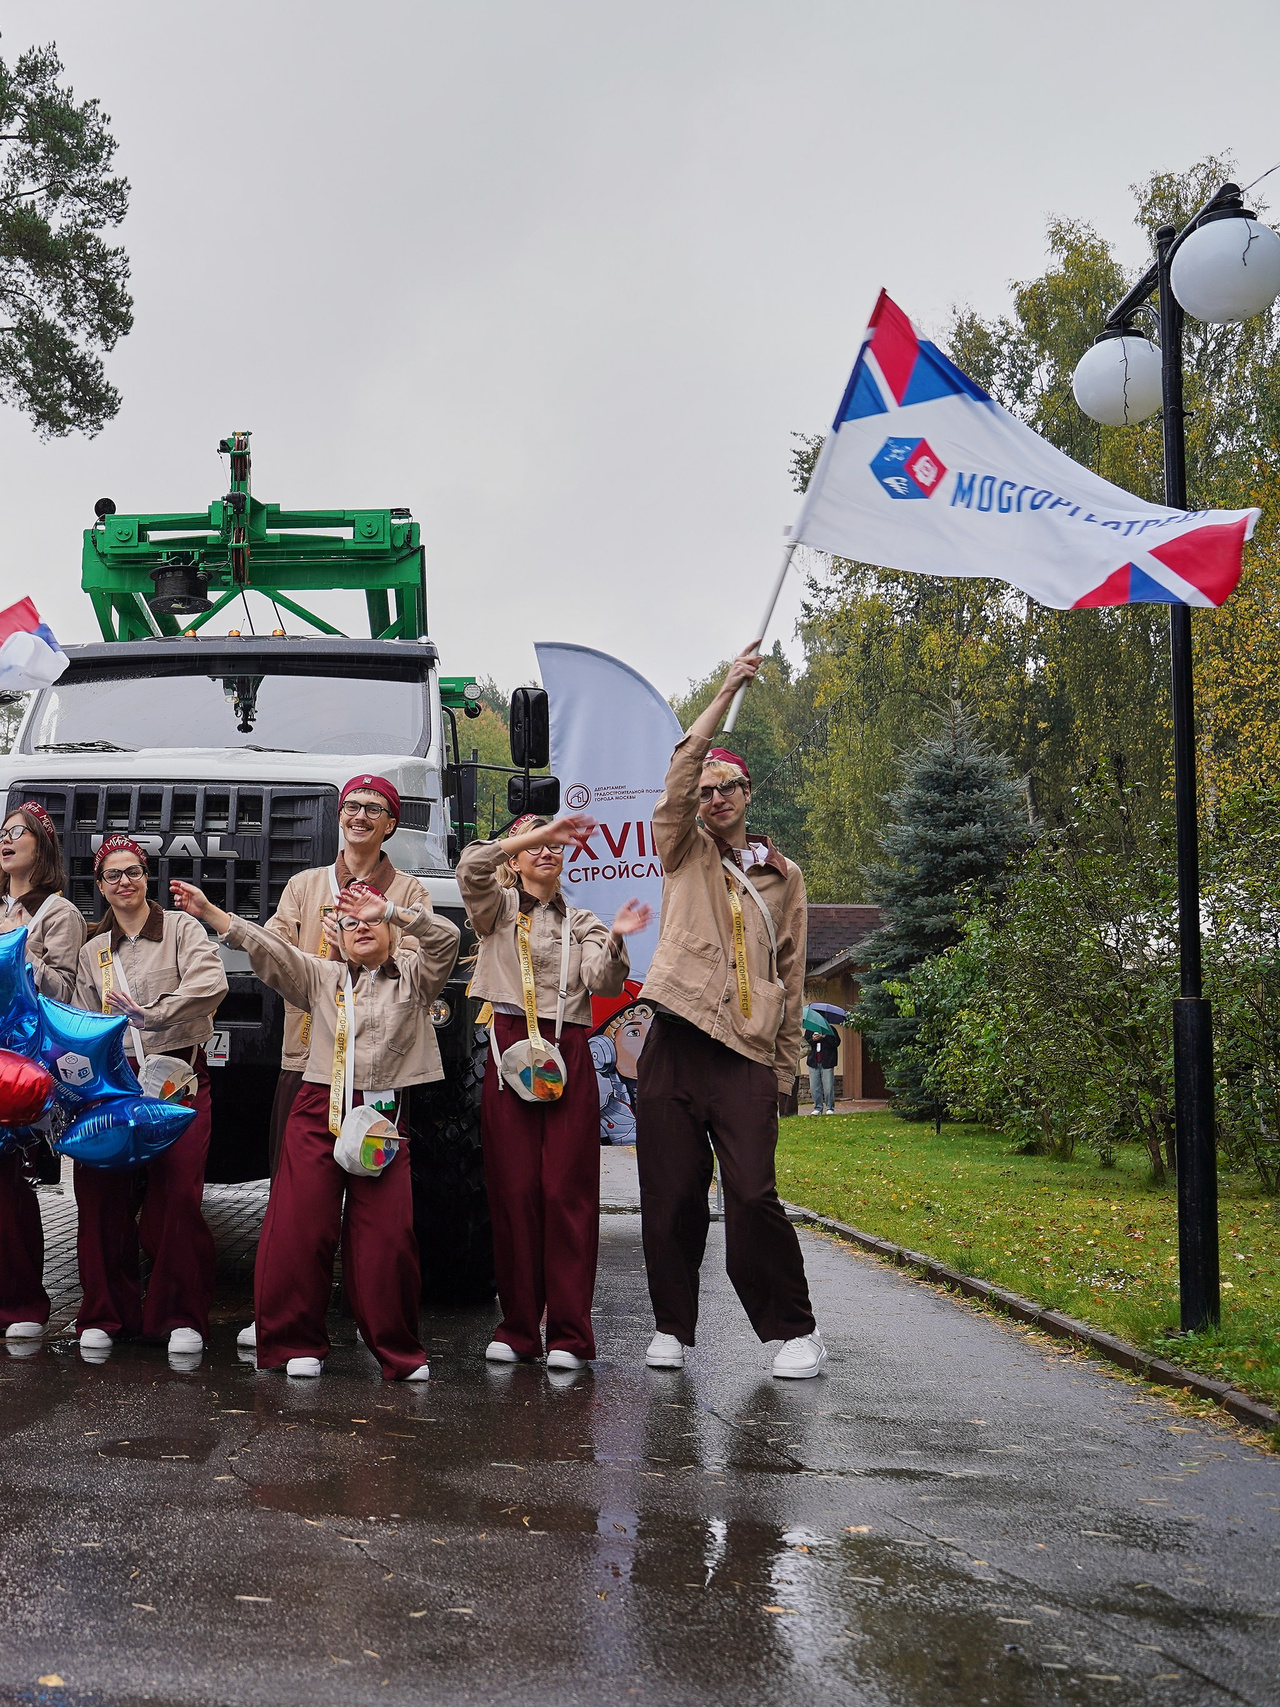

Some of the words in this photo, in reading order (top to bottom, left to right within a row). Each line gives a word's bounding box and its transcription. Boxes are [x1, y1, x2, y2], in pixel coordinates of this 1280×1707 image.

[737, 950, 749, 1012] МОСГОРГЕОТРЕСТ
[525, 989, 541, 1047] МОСГОРГЕОТРЕСТ
[331, 1069, 341, 1132] МОСГОРГЕОТРЕСТ
